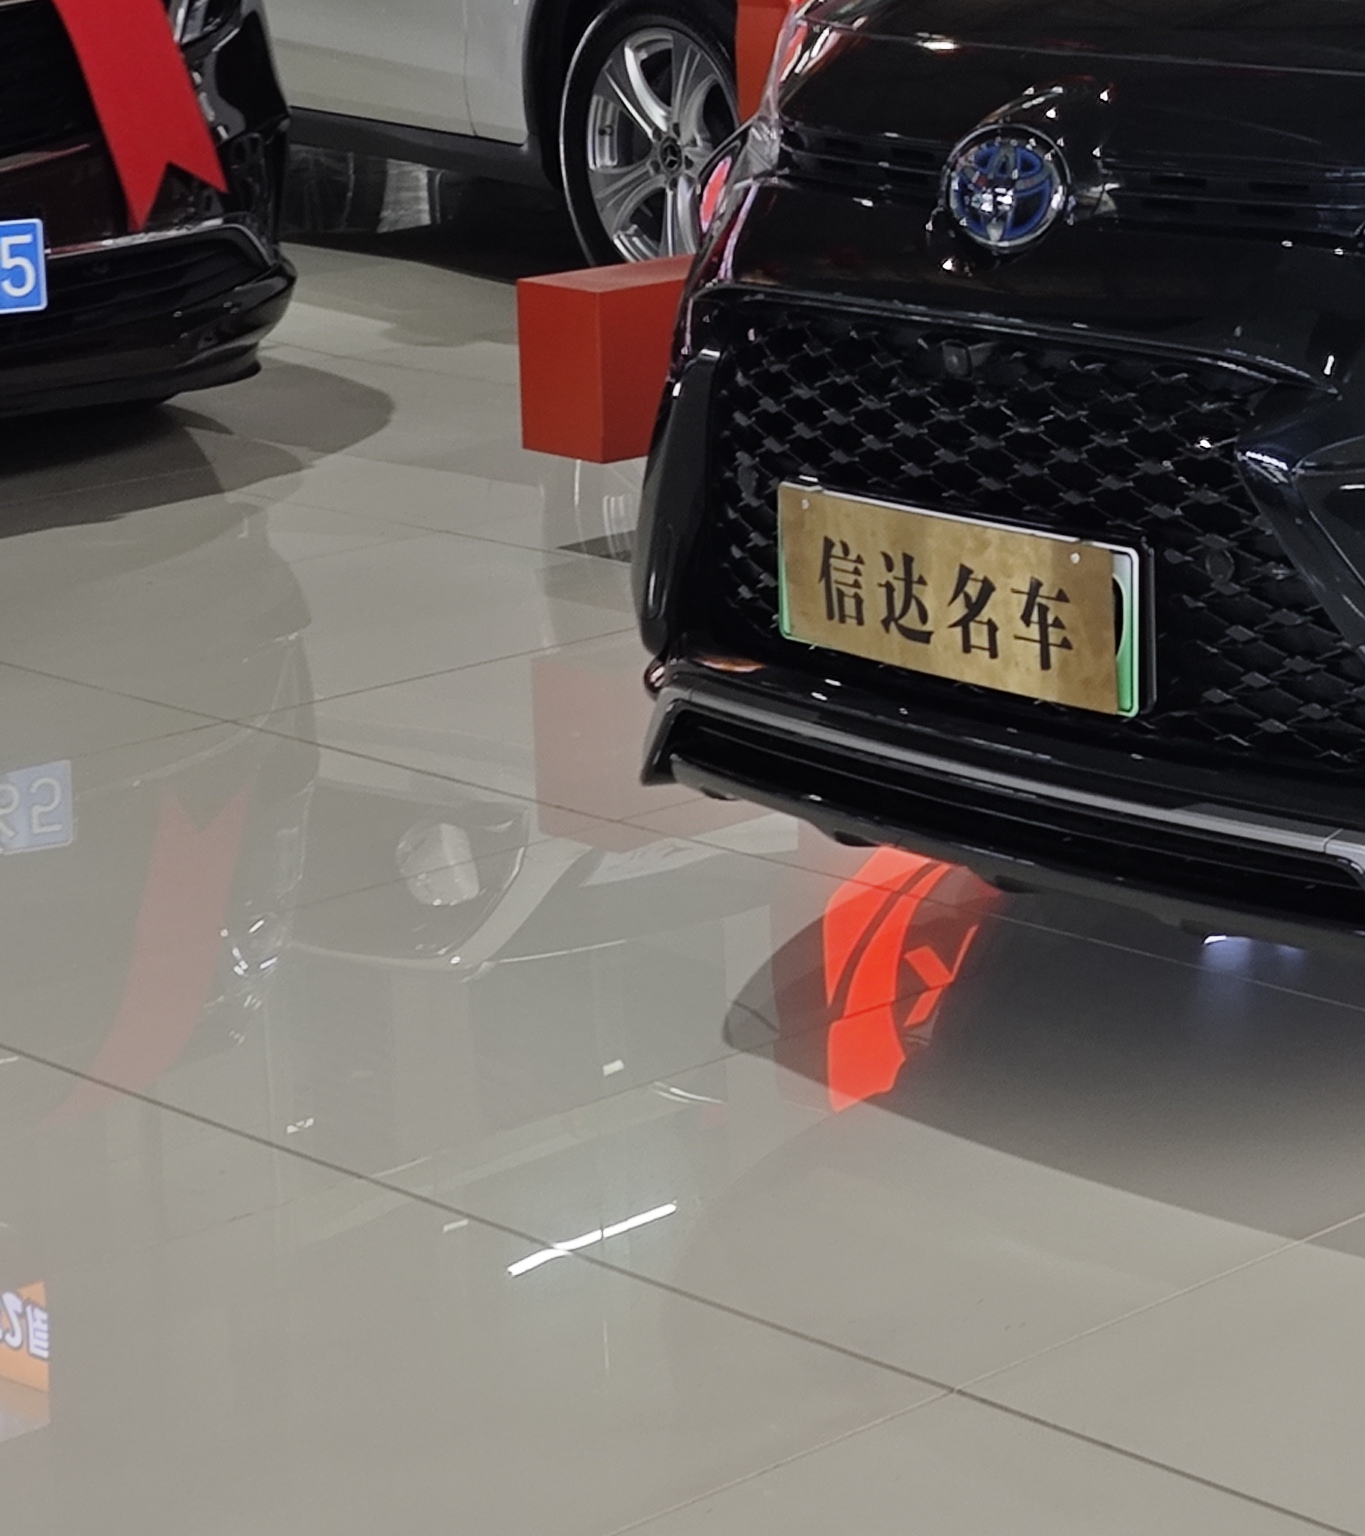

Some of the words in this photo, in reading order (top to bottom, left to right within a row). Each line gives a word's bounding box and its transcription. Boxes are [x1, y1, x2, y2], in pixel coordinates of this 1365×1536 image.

[1, 233, 36, 298] 5
[818, 534, 1073, 672] 信达名车
